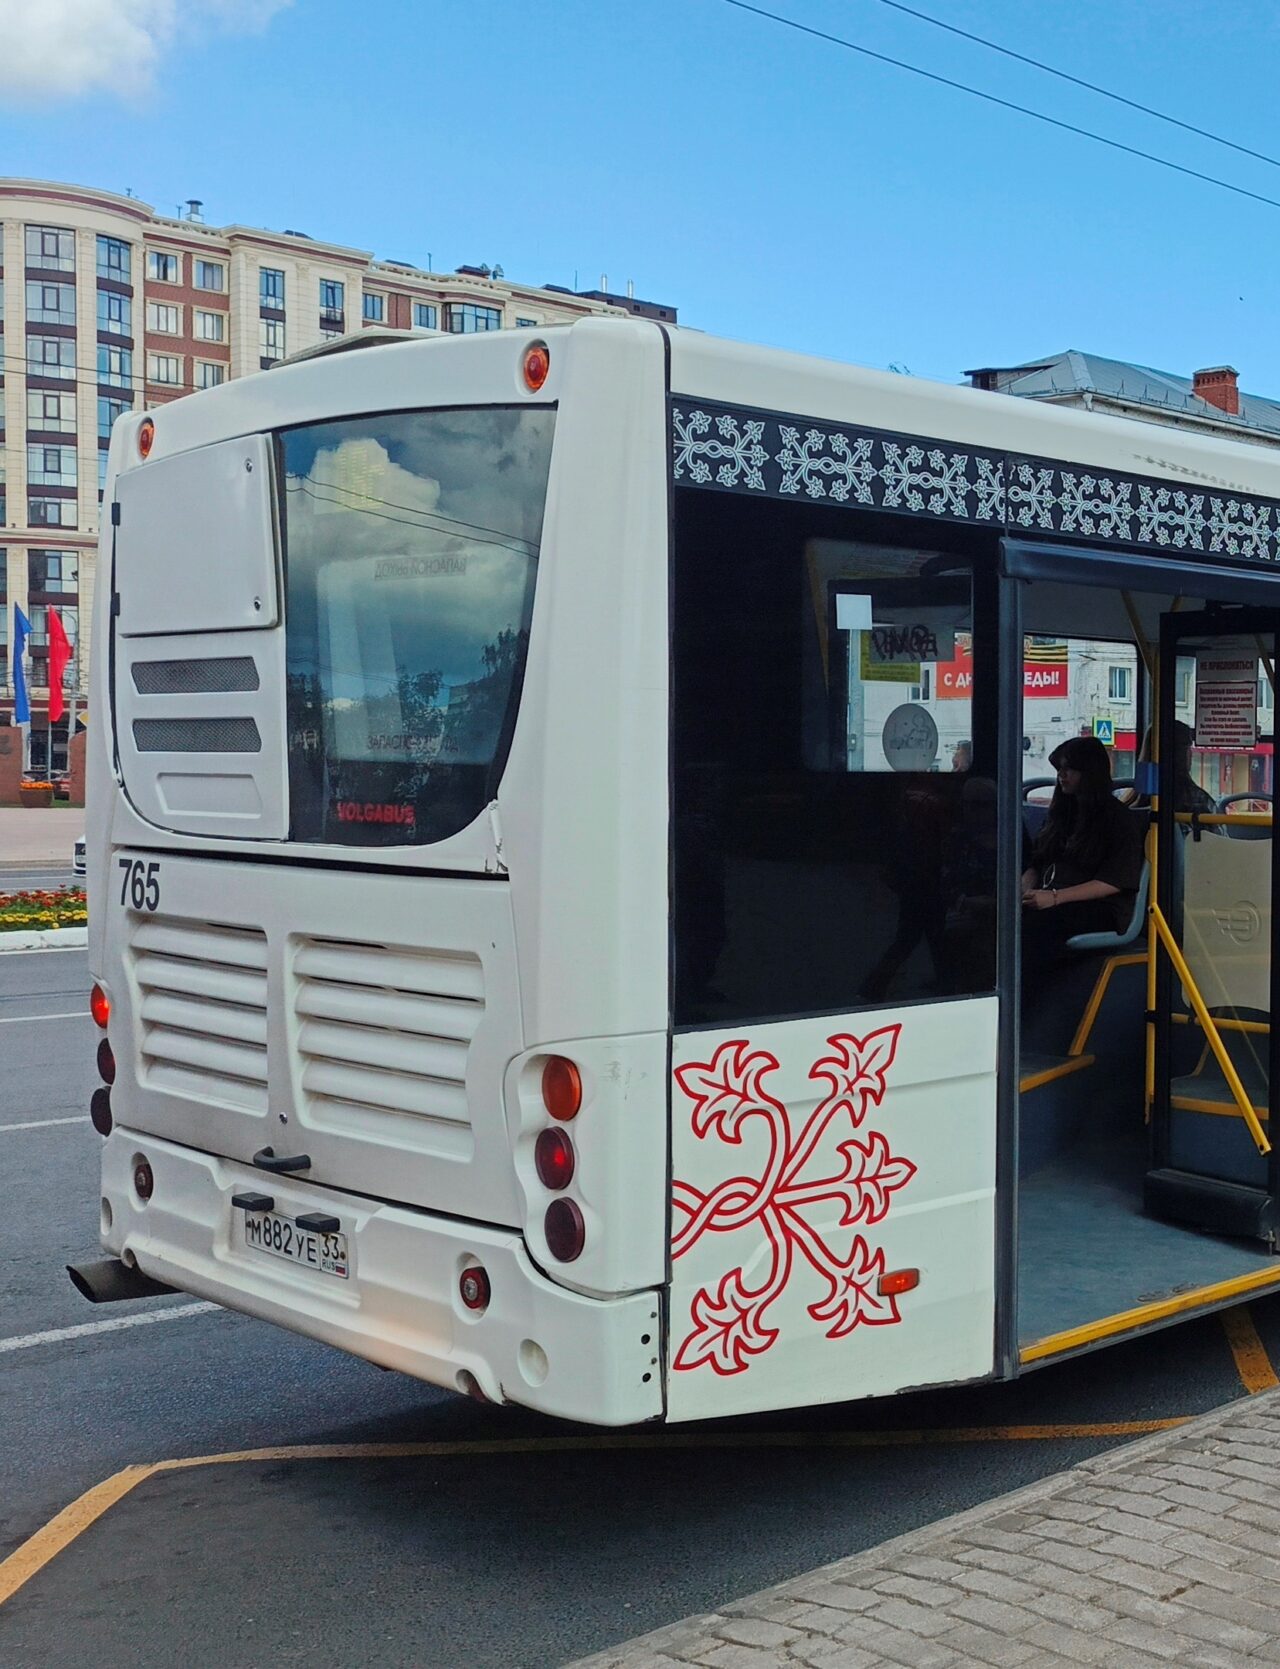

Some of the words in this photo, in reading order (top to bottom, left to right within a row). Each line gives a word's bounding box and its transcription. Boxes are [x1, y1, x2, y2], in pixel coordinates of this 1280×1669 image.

[943, 675, 955, 687] С
[1023, 672, 1061, 688] ЕДЫ!
[336, 801, 416, 825] VOLGABUS
[119, 858, 160, 912] 765
[250, 1216, 317, 1263] М882УЕ
[321, 1232, 340, 1260] 33
[322, 1258, 337, 1271] RUS
